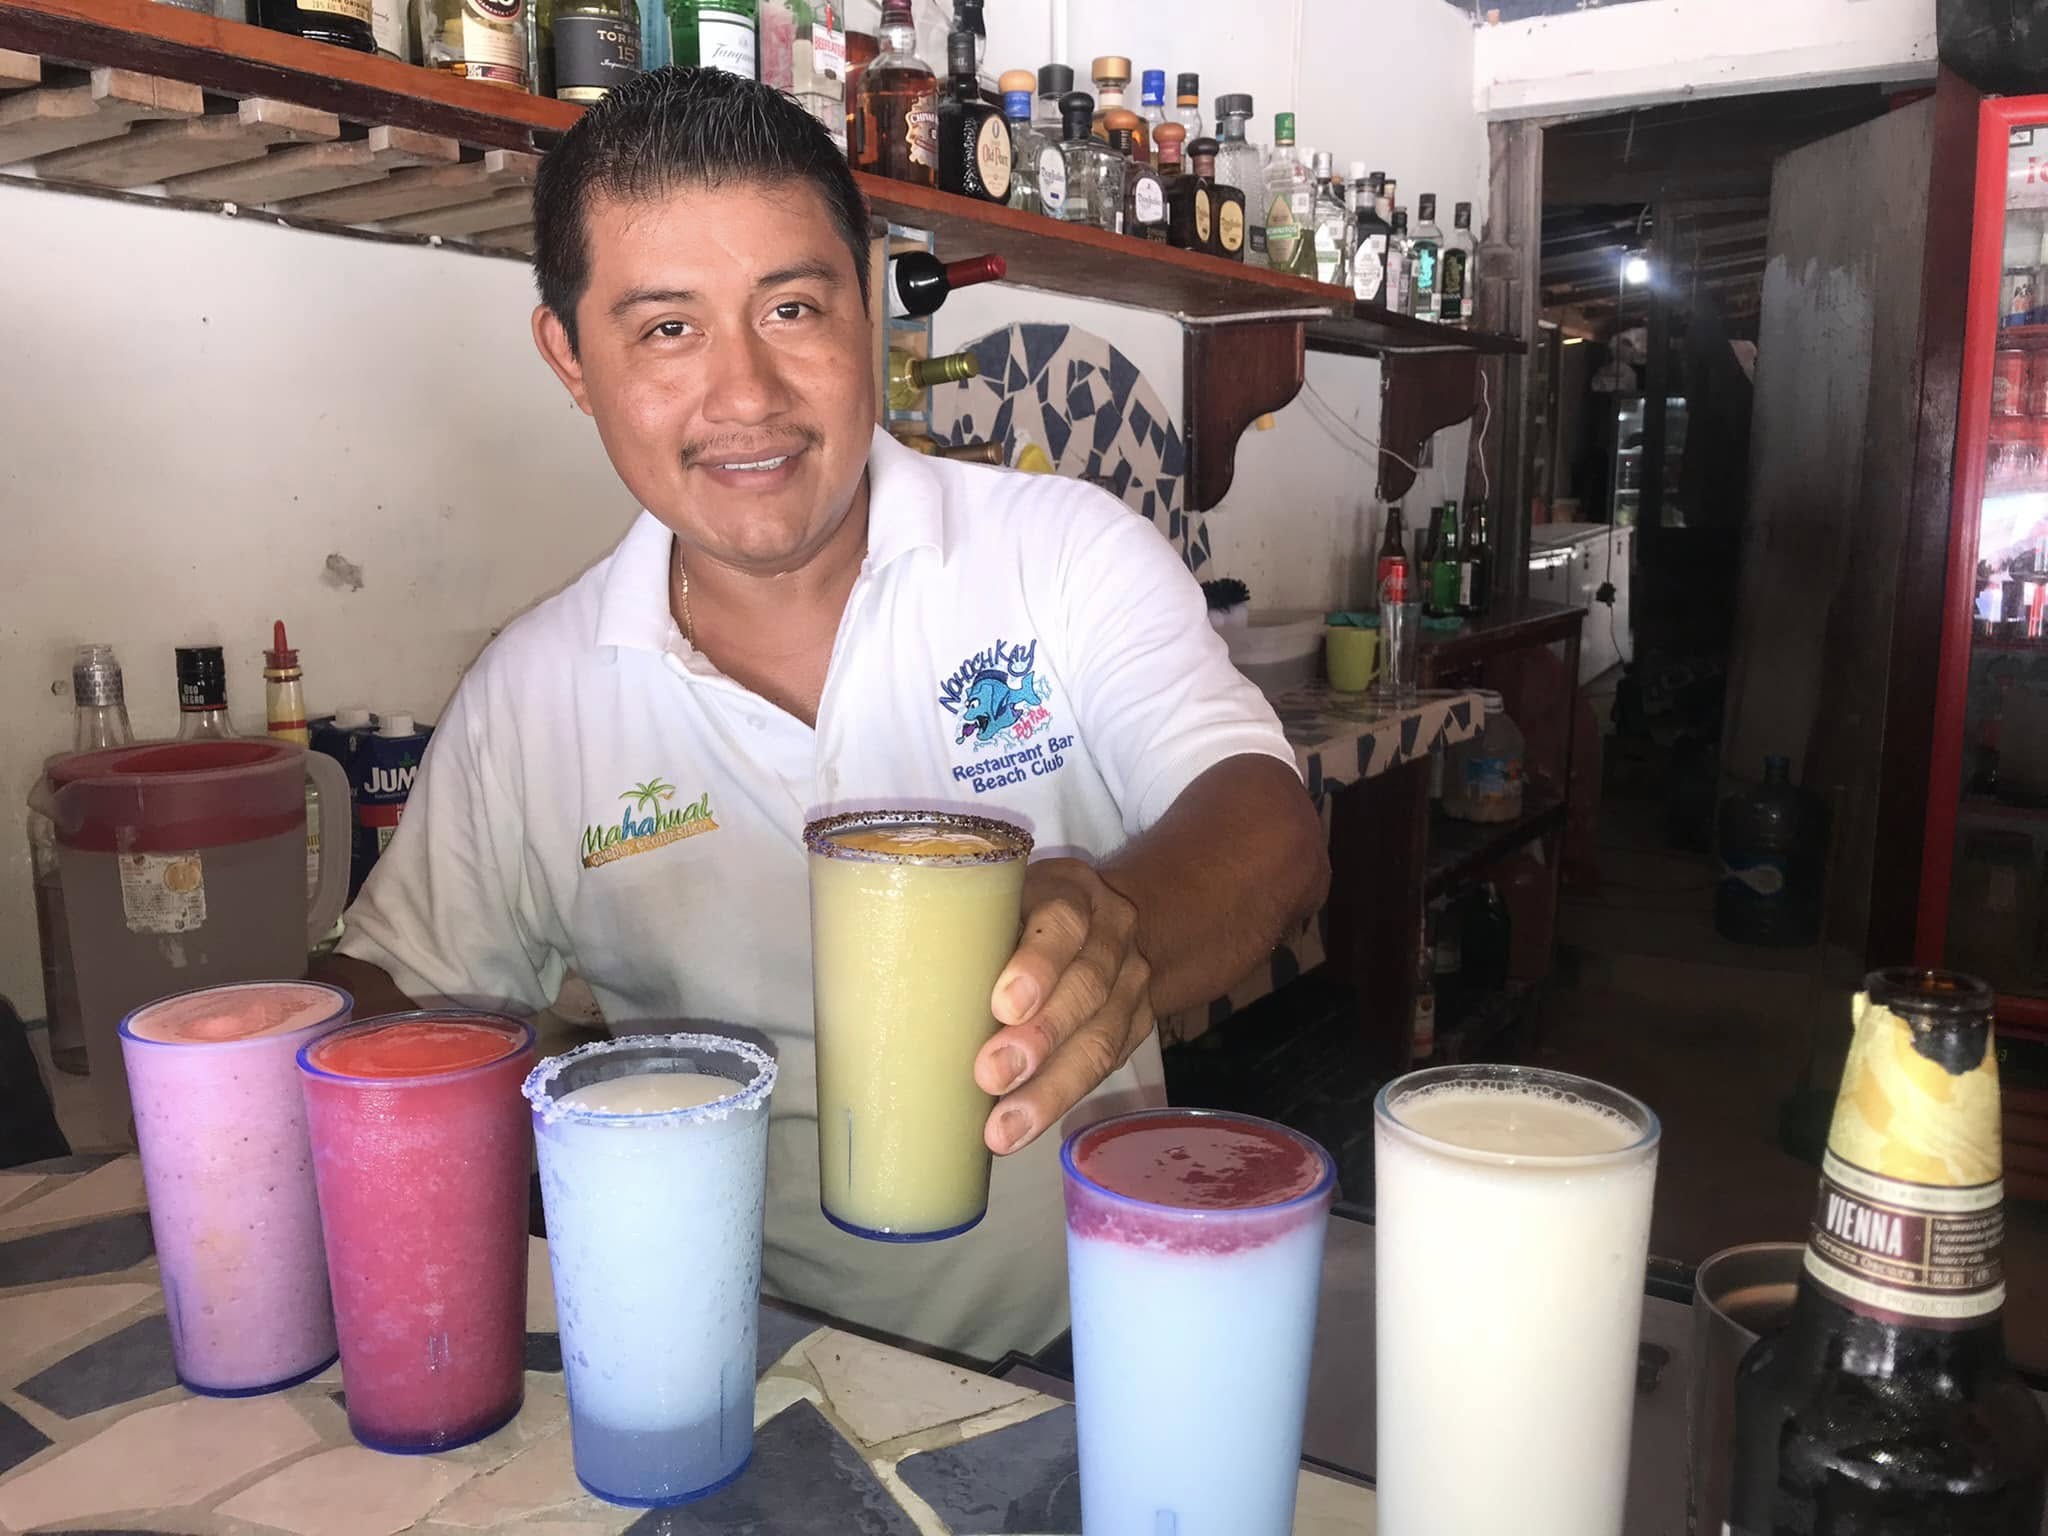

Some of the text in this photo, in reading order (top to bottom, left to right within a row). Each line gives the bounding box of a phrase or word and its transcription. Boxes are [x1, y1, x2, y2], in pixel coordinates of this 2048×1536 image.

[617, 46, 636, 63] 15
[982, 144, 995, 161] Old
[952, 735, 1074, 782] Restaurant Bar
[973, 755, 1064, 793] Beach Club
[581, 792, 713, 866] Mahahual
[1826, 1193, 1903, 1257] VIENNA
[1815, 1232, 1916, 1282] Cerveza Oscura
